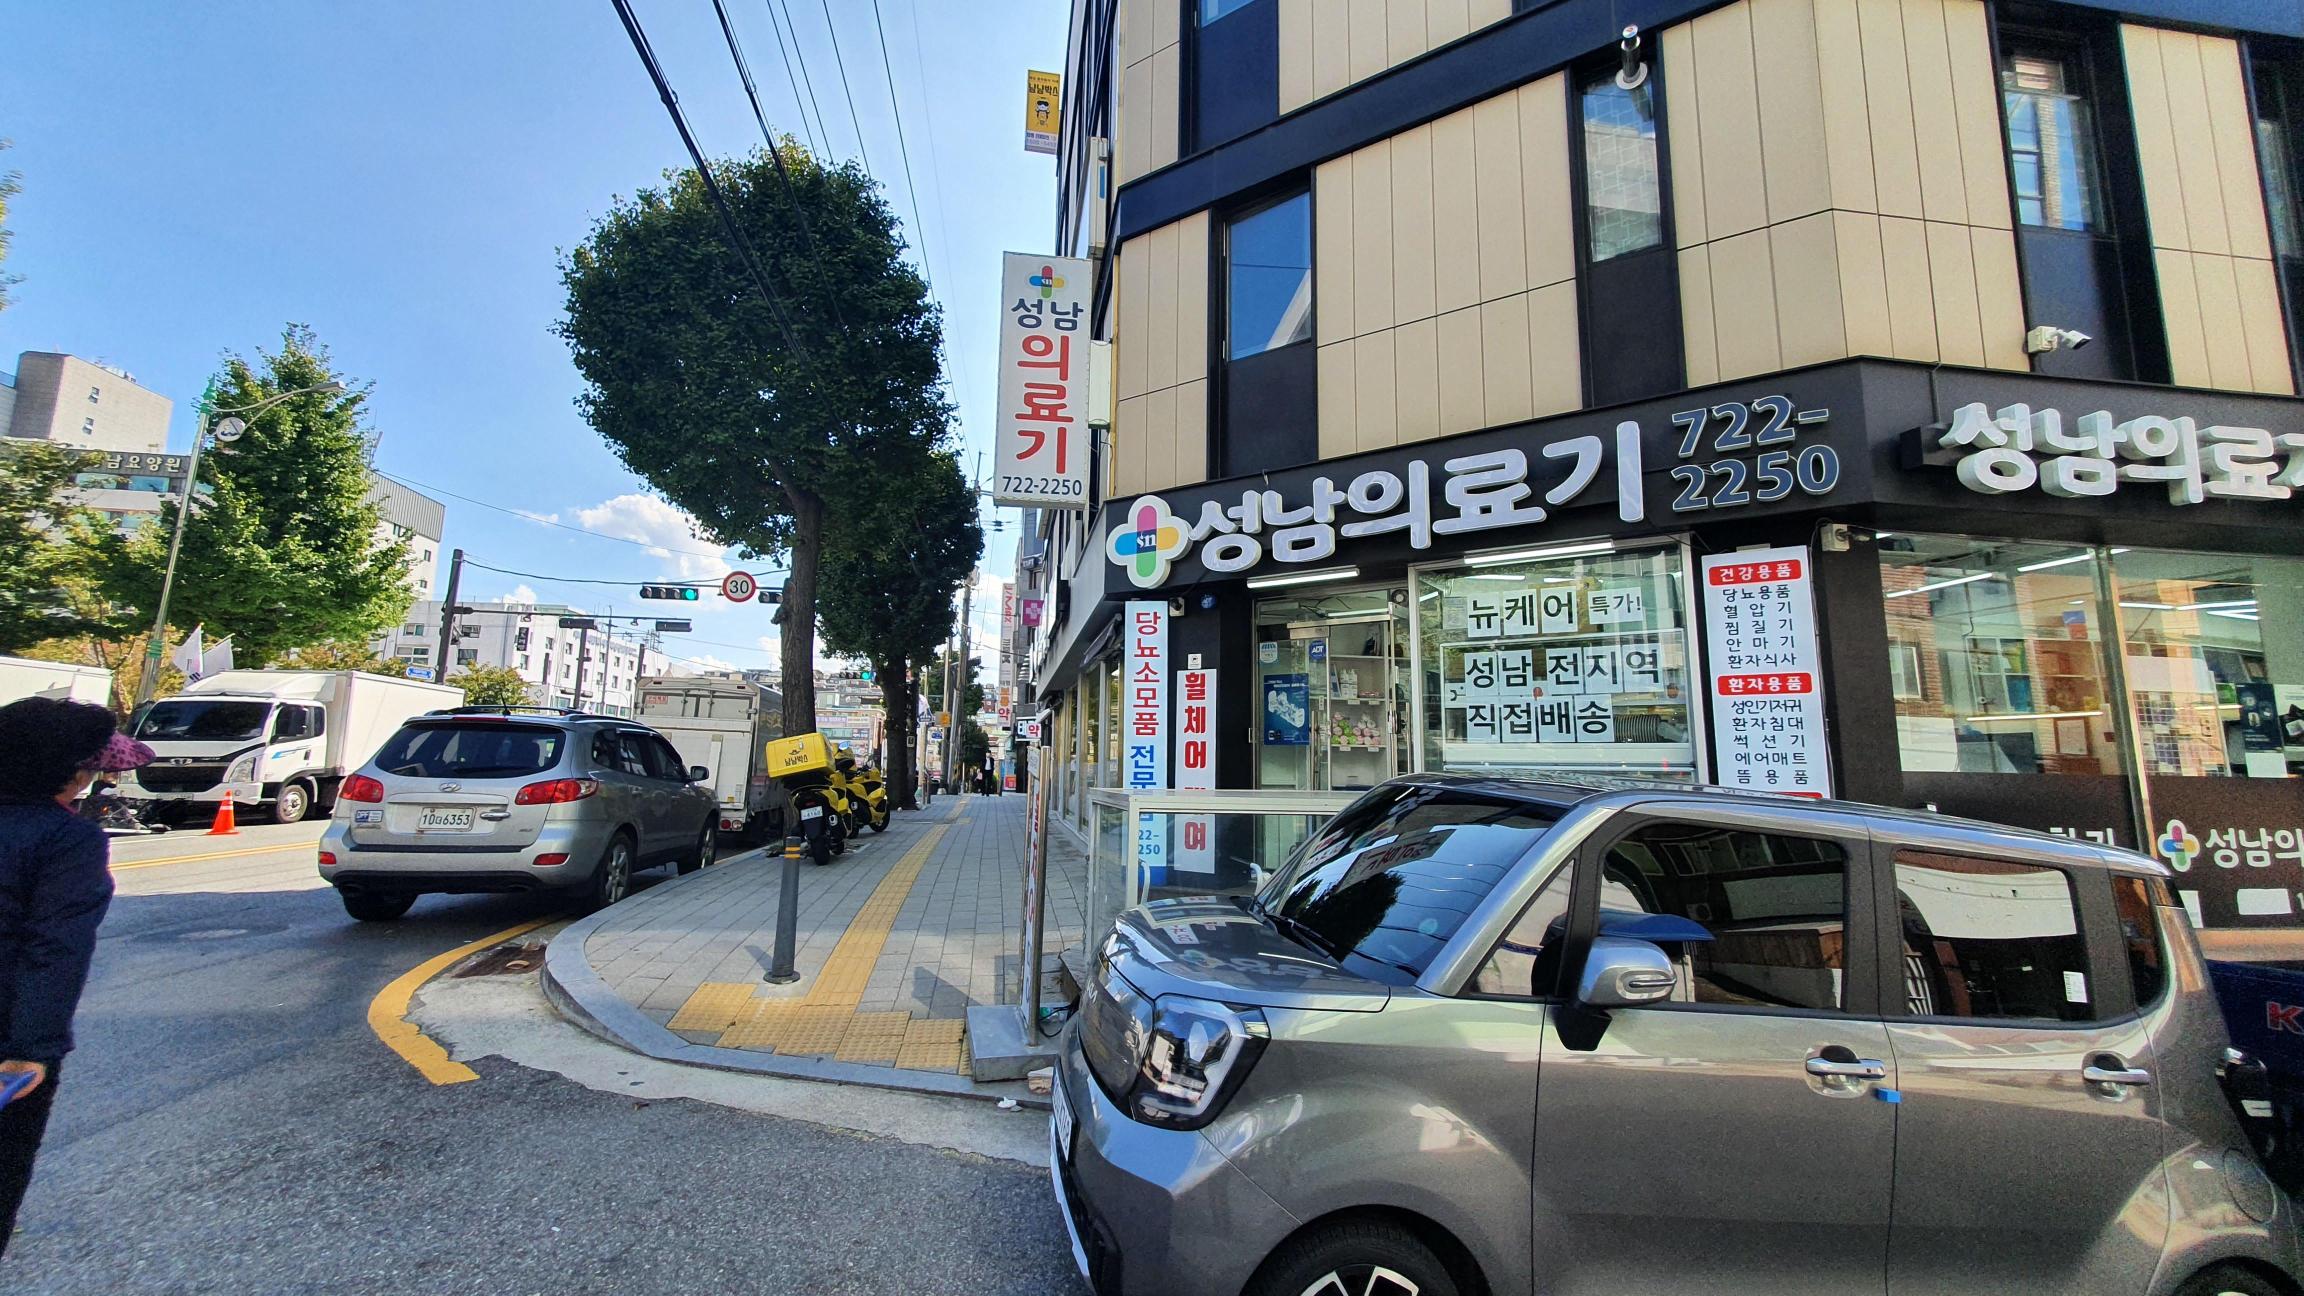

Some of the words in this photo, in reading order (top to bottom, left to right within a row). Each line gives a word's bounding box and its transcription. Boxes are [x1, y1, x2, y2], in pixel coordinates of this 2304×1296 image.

[1011, 298, 1084, 331] 성남
[1014, 335, 1074, 475] 의료기
[1672, 395, 1829, 459] 722-
[106, 454, 181, 473] 남요양원
[1002, 476, 1082, 496] 722-2250
[1671, 445, 1840, 512] 2250
[1189, 420, 1645, 573] 성남의료기
[1719, 562, 1792, 582] 건강용품
[729, 580, 749, 594] 30
[1722, 584, 1791, 603] 당뇨용품
[1468, 591, 1574, 630] 뉴케어
[1589, 593, 1641, 616] 특가!
[1311, 645, 1324, 654] ADT
[1466, 655, 1532, 689] 성남
[1548, 649, 1660, 685] 전지역
[1728, 652, 1797, 669] 환자식사
[1132, 611, 1162, 736] 당뇨소모품
[1728, 675, 1802, 693] 환자용품
[1731, 699, 1802, 715] 성인기저귀
[1183, 672, 1207, 769] 휠체어
[1468, 700, 1612, 736] 직접배송
[1732, 717, 1804, 732] 환자침대
[1735, 752, 1807, 766] 에어매트
